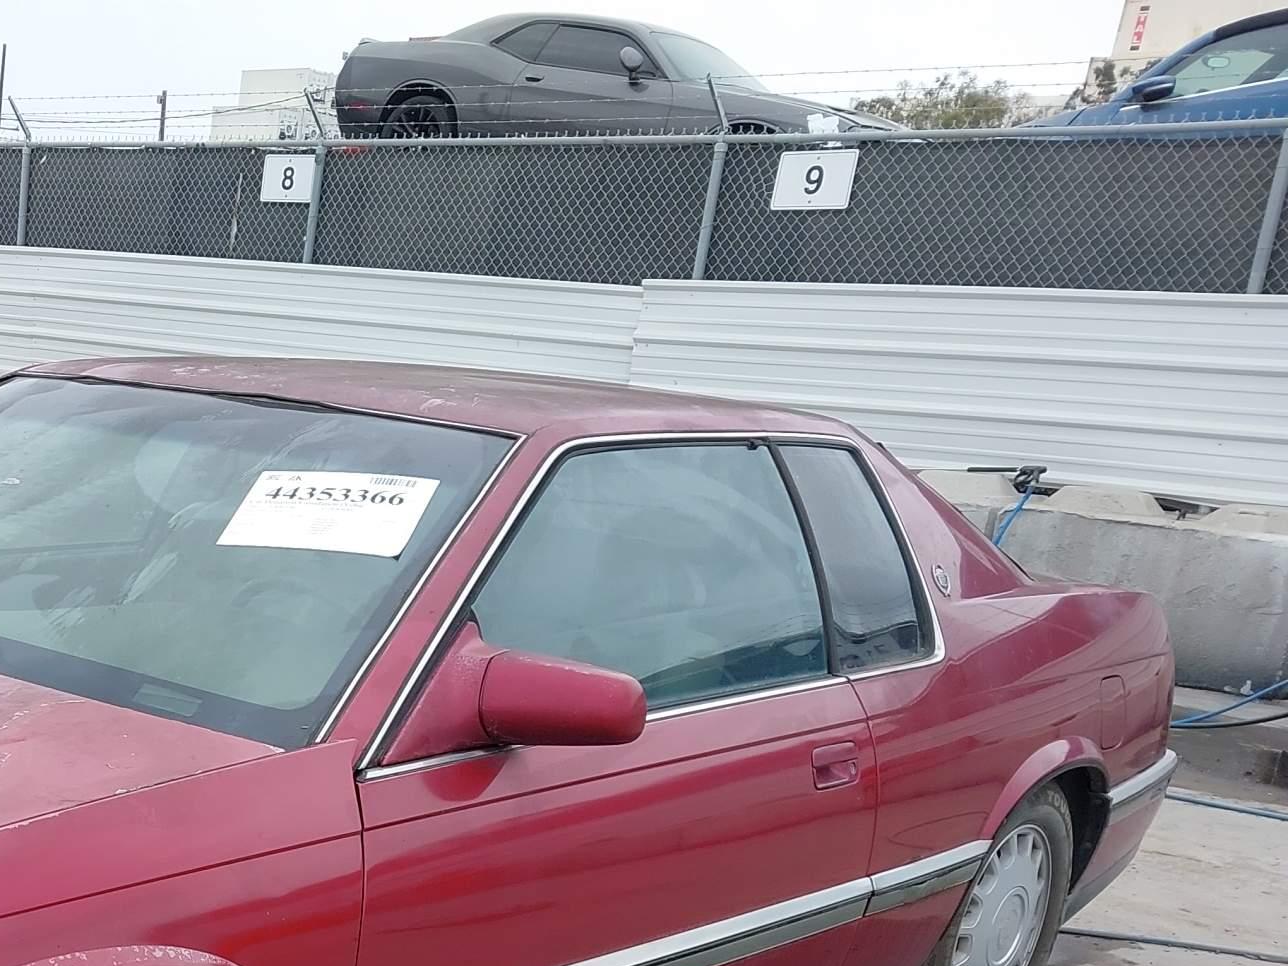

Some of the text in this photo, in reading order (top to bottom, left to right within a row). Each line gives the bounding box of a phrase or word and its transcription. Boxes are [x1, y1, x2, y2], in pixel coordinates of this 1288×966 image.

[281, 166, 295, 191] 8
[803, 165, 825, 195] 9
[265, 486, 409, 507] 44353366
